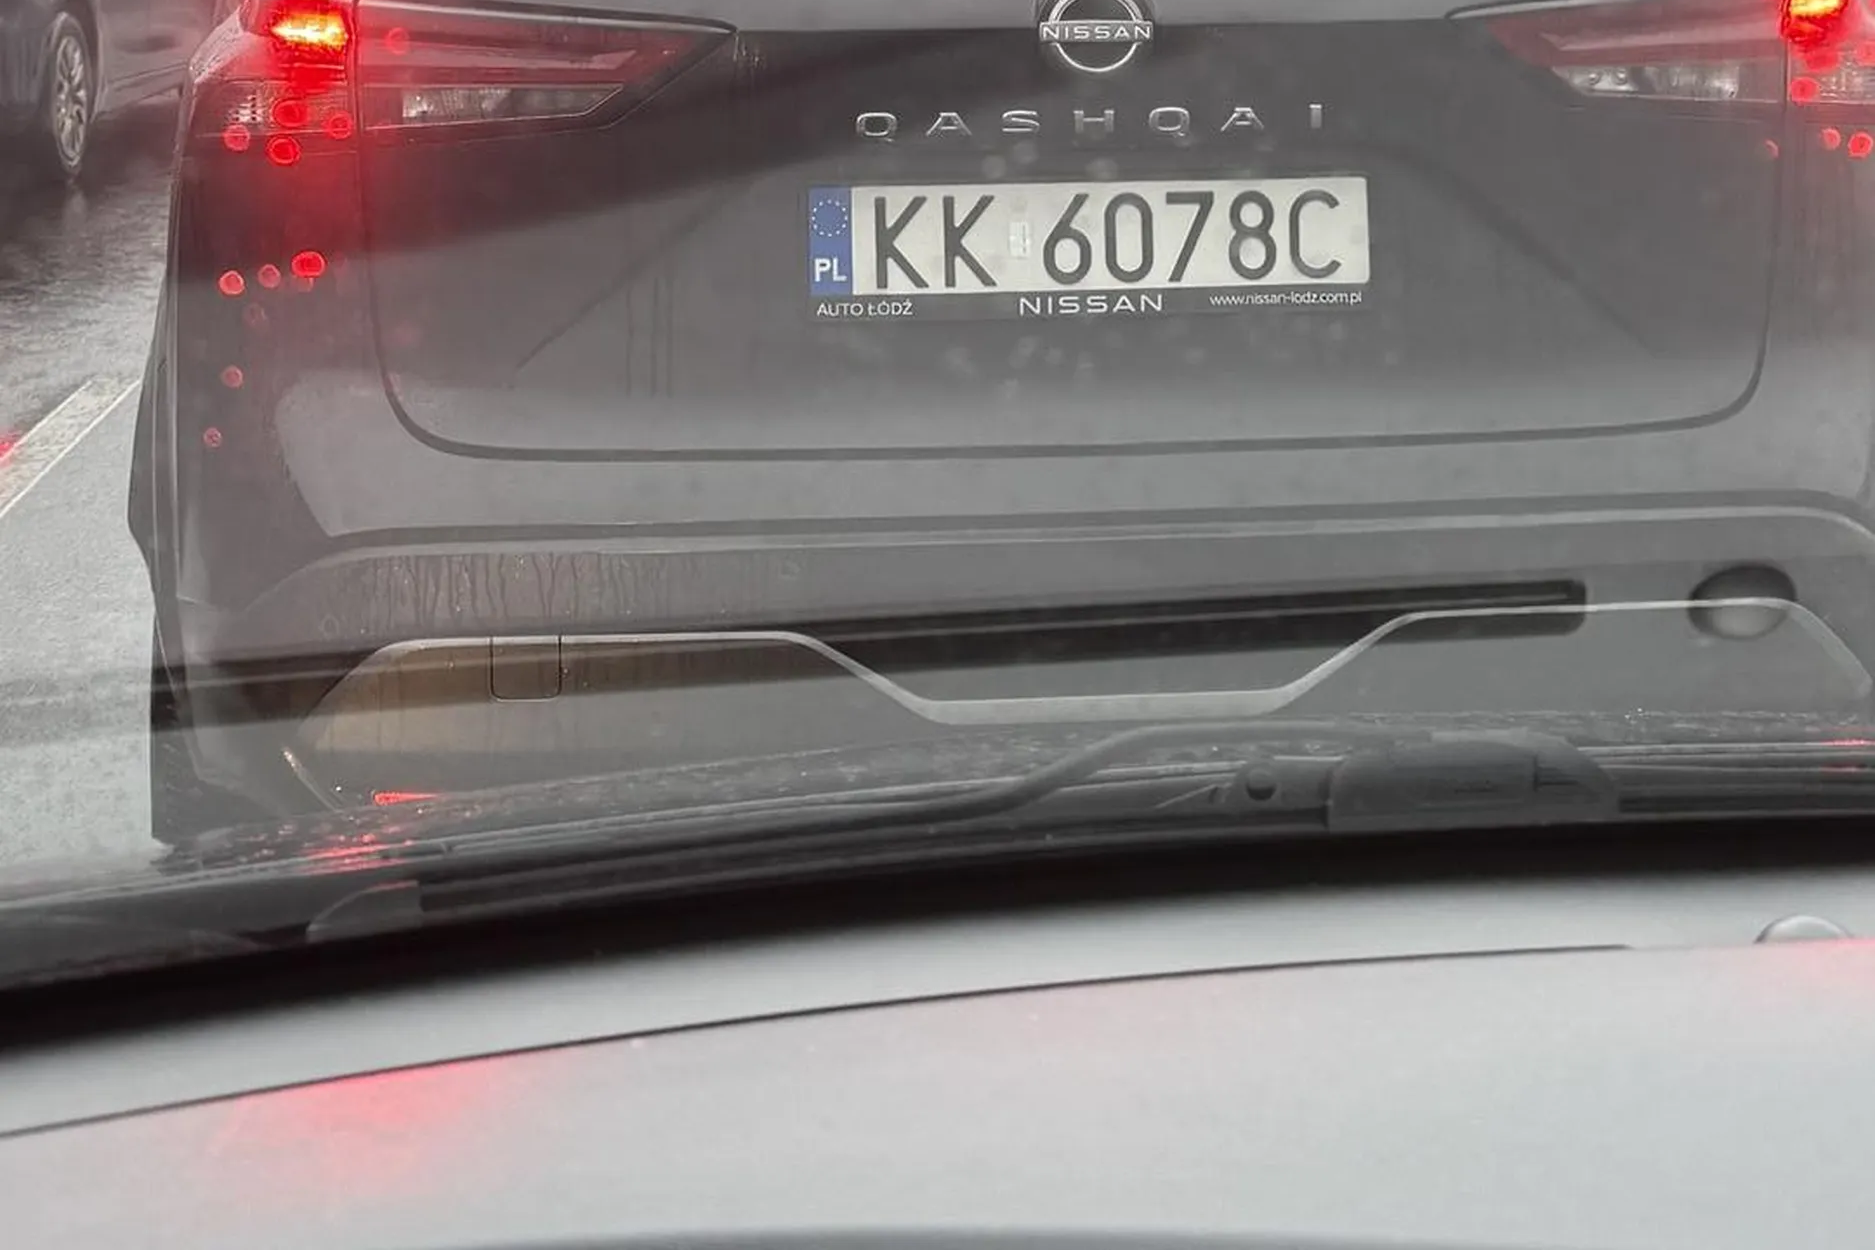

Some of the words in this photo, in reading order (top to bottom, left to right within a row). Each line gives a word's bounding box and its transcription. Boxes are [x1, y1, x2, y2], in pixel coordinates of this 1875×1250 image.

[1042, 25, 1150, 40] NISSAN
[855, 103, 1324, 141] QASHQAI
[873, 194, 998, 290] KK
[1043, 188, 1343, 285] 6078C
[813, 257, 848, 283] PL
[816, 302, 864, 317] AUTO
[868, 298, 914, 316] ŁÓDŹ
[1019, 293, 1163, 316] NISSAN
[1209, 290, 1363, 306] www.nissan-lodz.com.pl
